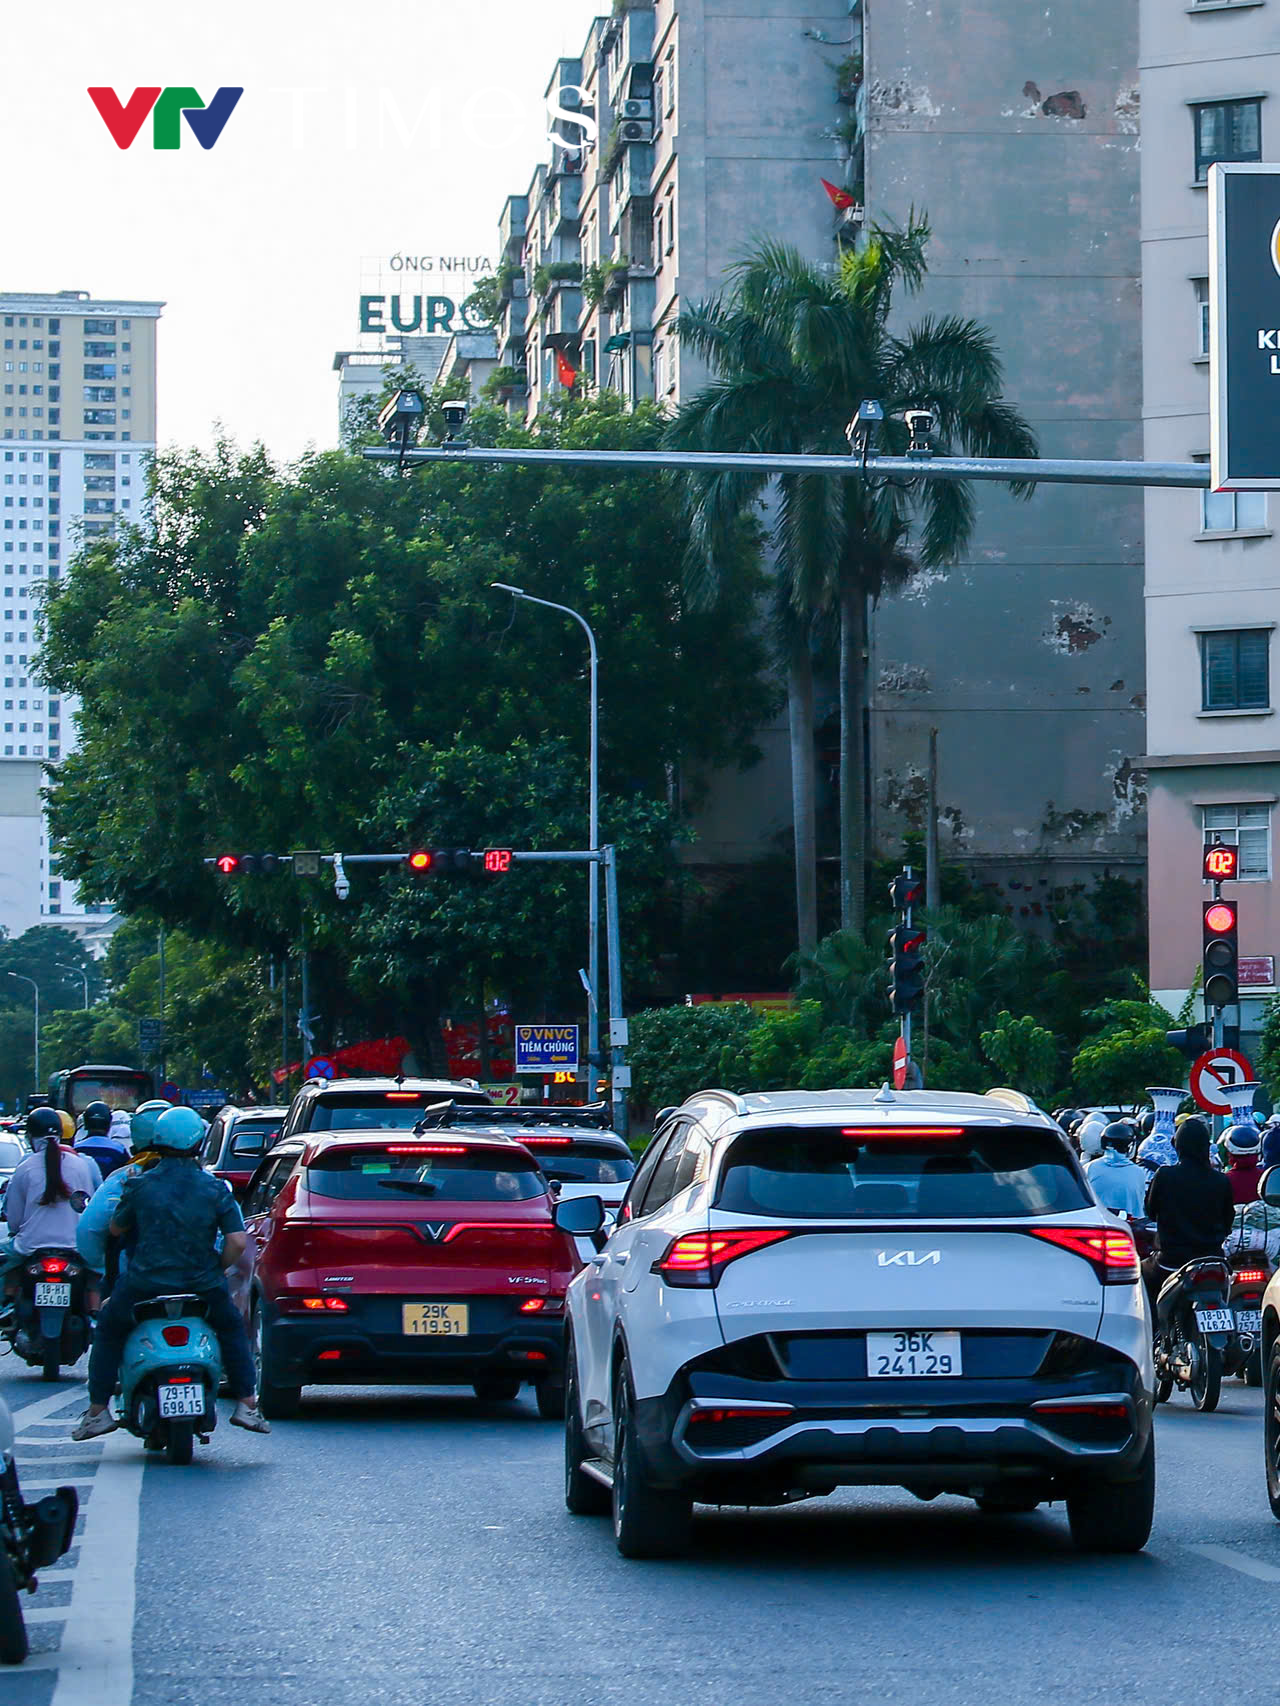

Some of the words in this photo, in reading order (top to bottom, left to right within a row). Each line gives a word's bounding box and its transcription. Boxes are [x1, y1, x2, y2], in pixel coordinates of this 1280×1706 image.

[390, 251, 433, 271] ỐNG
[439, 255, 492, 275] NHỰA
[484, 851, 511, 872] 102
[1208, 852, 1233, 873] 102
[533, 1028, 574, 1039] VNVC
[520, 1041, 542, 1052] TIÊM
[877, 1250, 941, 1267] KIA
[422, 1306, 448, 1318] 29K
[412, 1320, 460, 1334] 119.91
[893, 1334, 933, 1353] 36K
[877, 1356, 951, 1376] 241.29
[165, 1386, 196, 1400] 29-F1
[163, 1400, 202, 1415] 698.15
